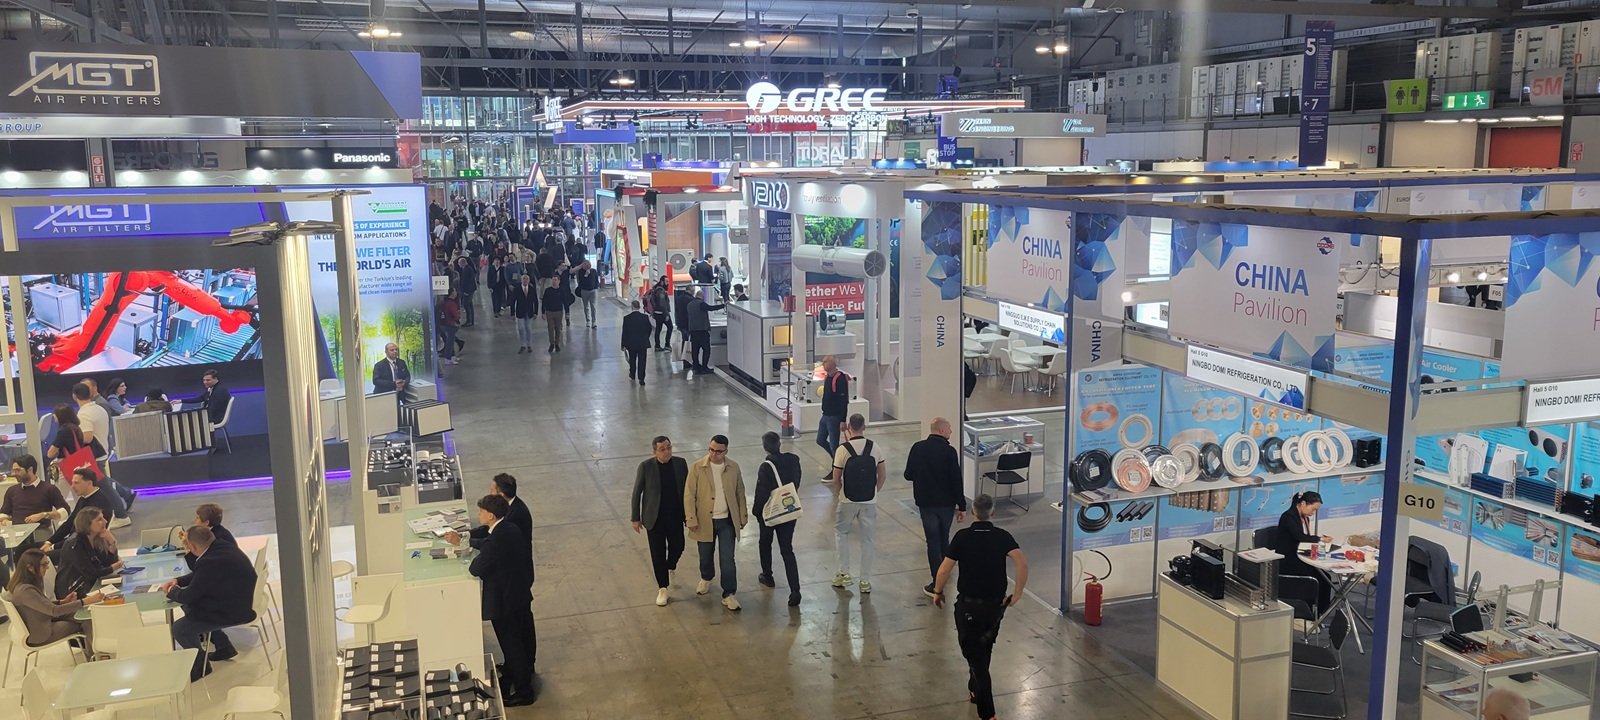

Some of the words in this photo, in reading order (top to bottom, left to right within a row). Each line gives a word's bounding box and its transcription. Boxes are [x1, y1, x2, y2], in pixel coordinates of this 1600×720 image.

[1305, 38, 1316, 56] 5
[1532, 75, 1563, 97] 5M
[34, 95, 65, 104] AIR
[80, 96, 161, 105] FILTERS
[786, 87, 888, 112] GREE
[1311, 98, 1319, 110] 7
[746, 115, 766, 123] HIGH
[334, 153, 391, 163] Panasonic
[88, 224, 151, 232] FILTERS
[369, 221, 406, 229] EXPERIENCE
[376, 246, 411, 257] FILTER
[1022, 236, 1062, 260] CHINA
[393, 258, 411, 268] AIR
[1022, 258, 1062, 281] Pavilion
[1235, 262, 1309, 297] CHINA
[839, 284, 856, 295] We
[1233, 292, 1308, 326] Pavilion
[936, 315, 945, 348] CHINA
[1091, 320, 1102, 363] CHINA
[1192, 359, 1211, 371] NINGBO
[1212, 363, 1226, 374] DOMI
[1226, 367, 1271, 387] REFRIGERATION
[1432, 362, 1457, 373] Cooler
[1535, 396, 1562, 407] NINGBO
[1564, 395, 1581, 405] DOMI
[1404, 494, 1435, 510] G10
